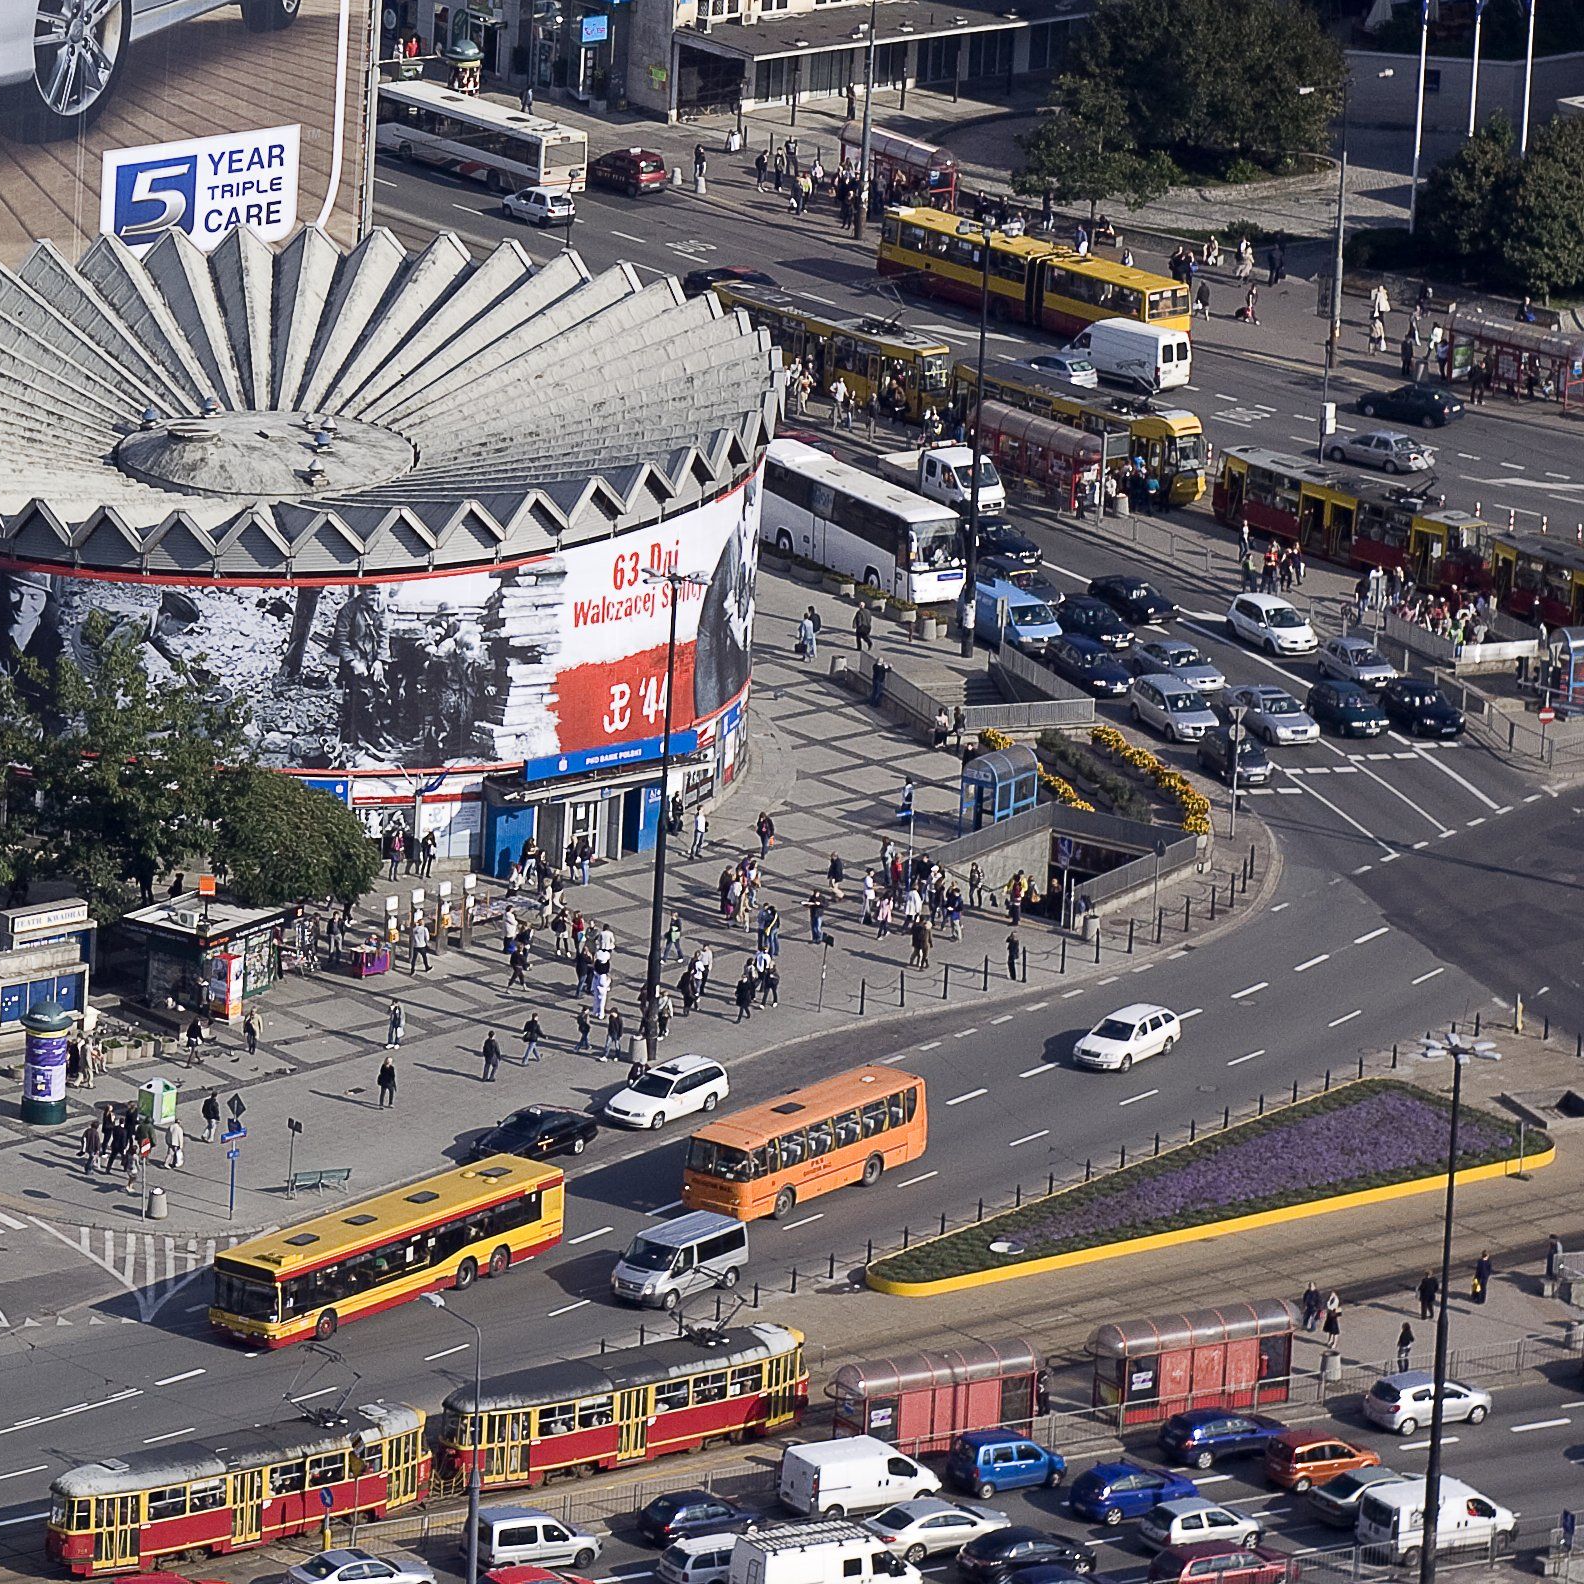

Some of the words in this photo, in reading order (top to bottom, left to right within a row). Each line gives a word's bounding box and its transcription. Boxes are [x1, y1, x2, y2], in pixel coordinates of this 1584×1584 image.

[121, 163, 190, 236] 5
[207, 144, 285, 176] YEAR
[207, 176, 283, 200] TRIPLE
[204, 200, 282, 233] CARE
[613, 551, 640, 591] 63
[650, 539, 680, 574] Dni
[573, 586, 656, 629] Walczącej
[600, 751, 619, 764] BANK
[619, 747, 643, 761] POLSKI
